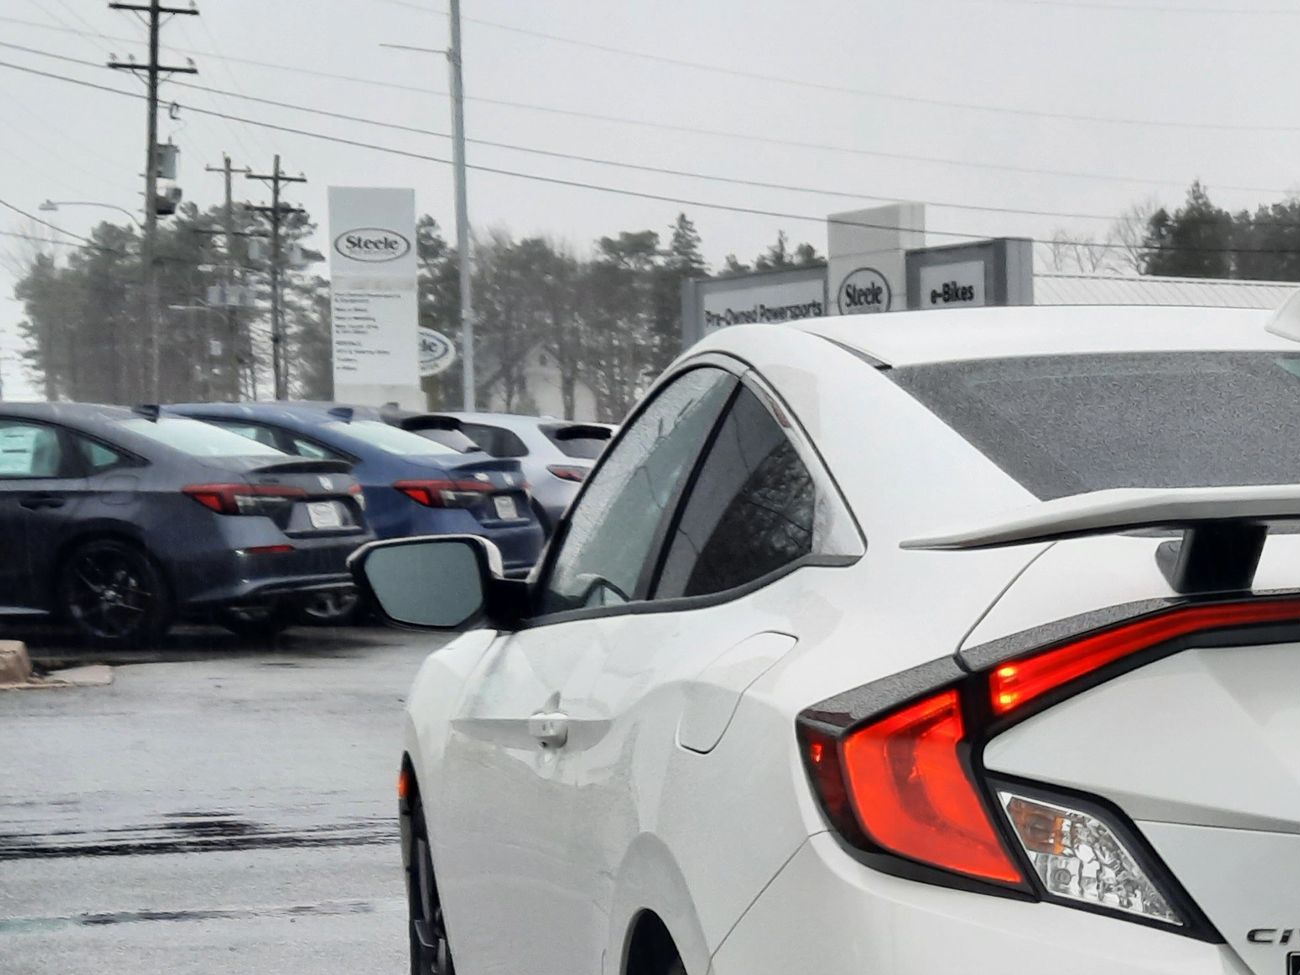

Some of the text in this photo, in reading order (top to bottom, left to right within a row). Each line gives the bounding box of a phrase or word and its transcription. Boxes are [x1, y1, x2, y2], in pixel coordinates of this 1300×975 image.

[345, 235, 399, 250] Steele
[845, 282, 883, 308] Steele
[930, 281, 975, 305] e-Bikes
